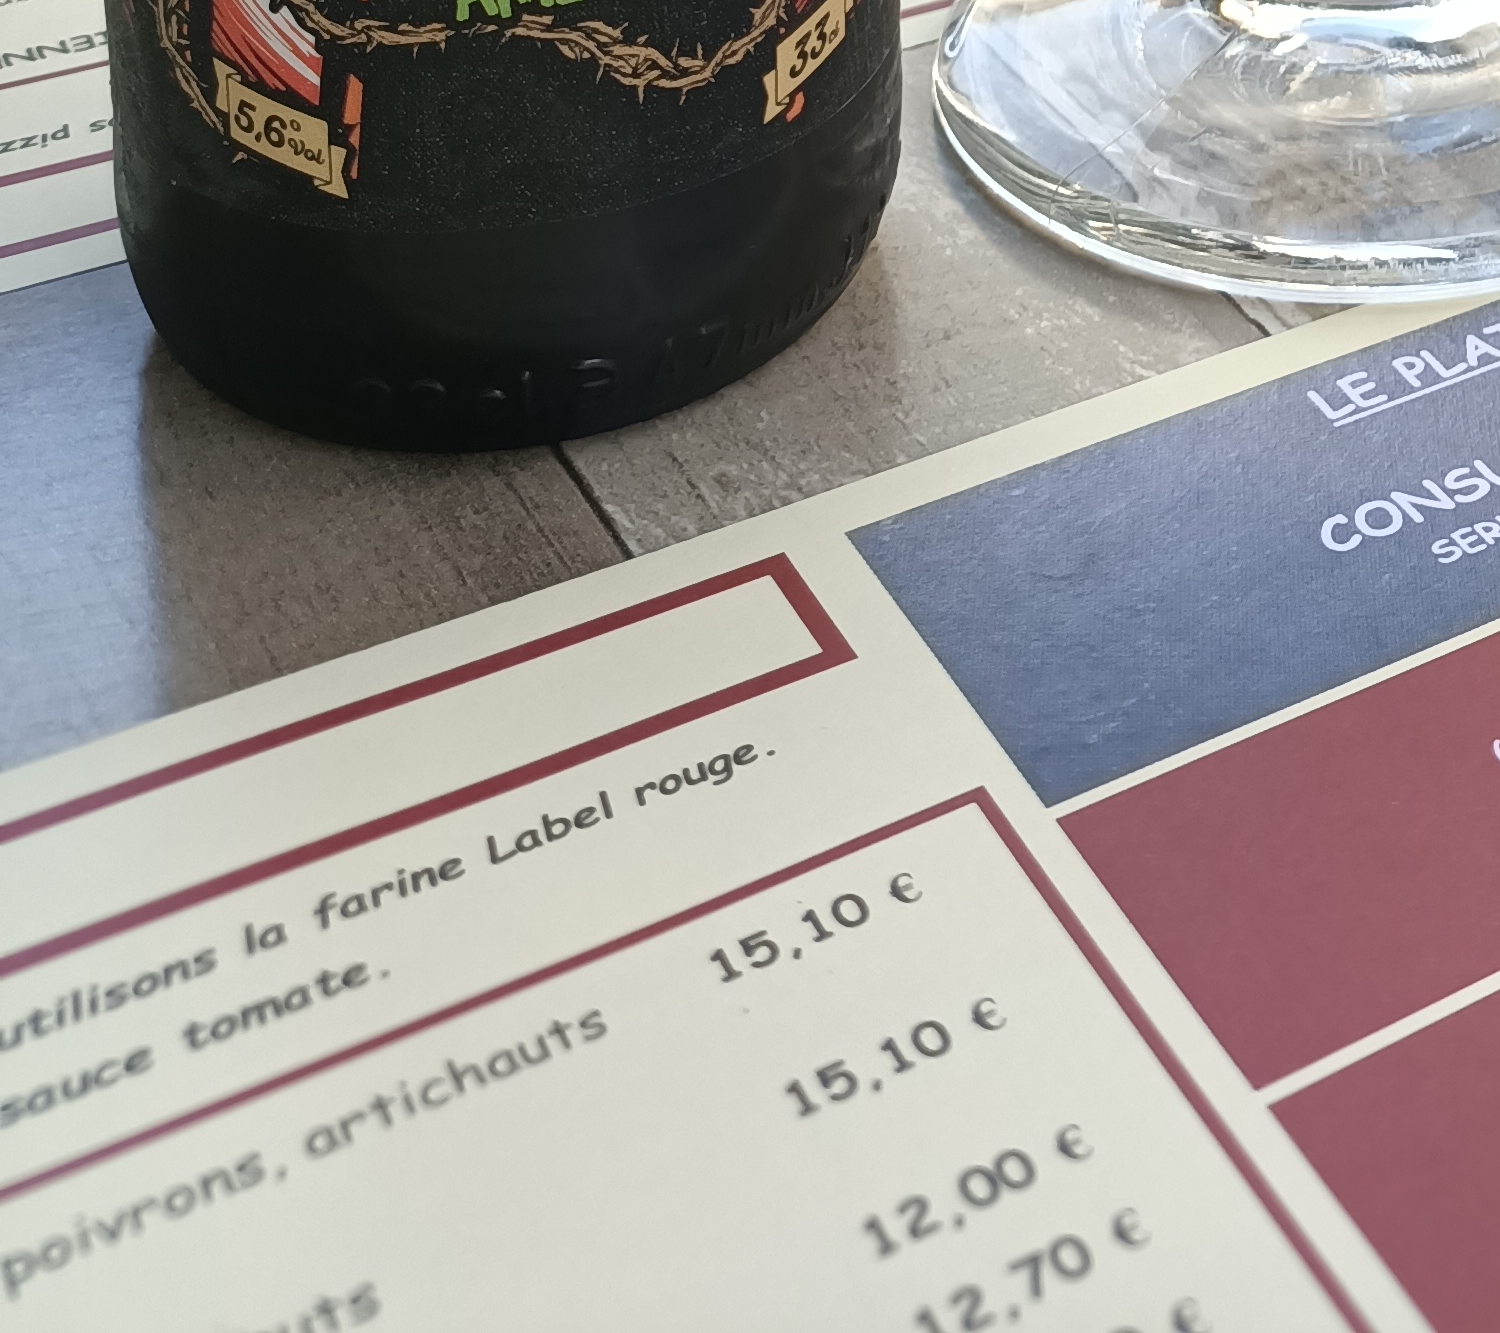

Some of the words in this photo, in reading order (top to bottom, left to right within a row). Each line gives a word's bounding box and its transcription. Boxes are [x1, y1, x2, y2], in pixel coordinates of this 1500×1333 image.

[1306, 370, 1374, 423] LE
[243, 921, 290, 959] la
[312, 855, 466, 931] farine
[485, 789, 616, 866] Label
[633, 740, 778, 808] rouge.
[0, 1044, 156, 1130] sauce
[181, 961, 393, 1052] tomate.
[0, 1149, 290, 1304] poivrons,
[302, 1006, 609, 1162] artichauts
[709, 892, 870, 983] 15,10
[888, 871, 924, 904] €
[784, 1019, 953, 1118] 15,10
[970, 996, 1008, 1031] €
[862, 1147, 1039, 1259] 12,00
[1054, 1123, 1096, 1162] €
[1110, 1206, 1153, 1249] €
